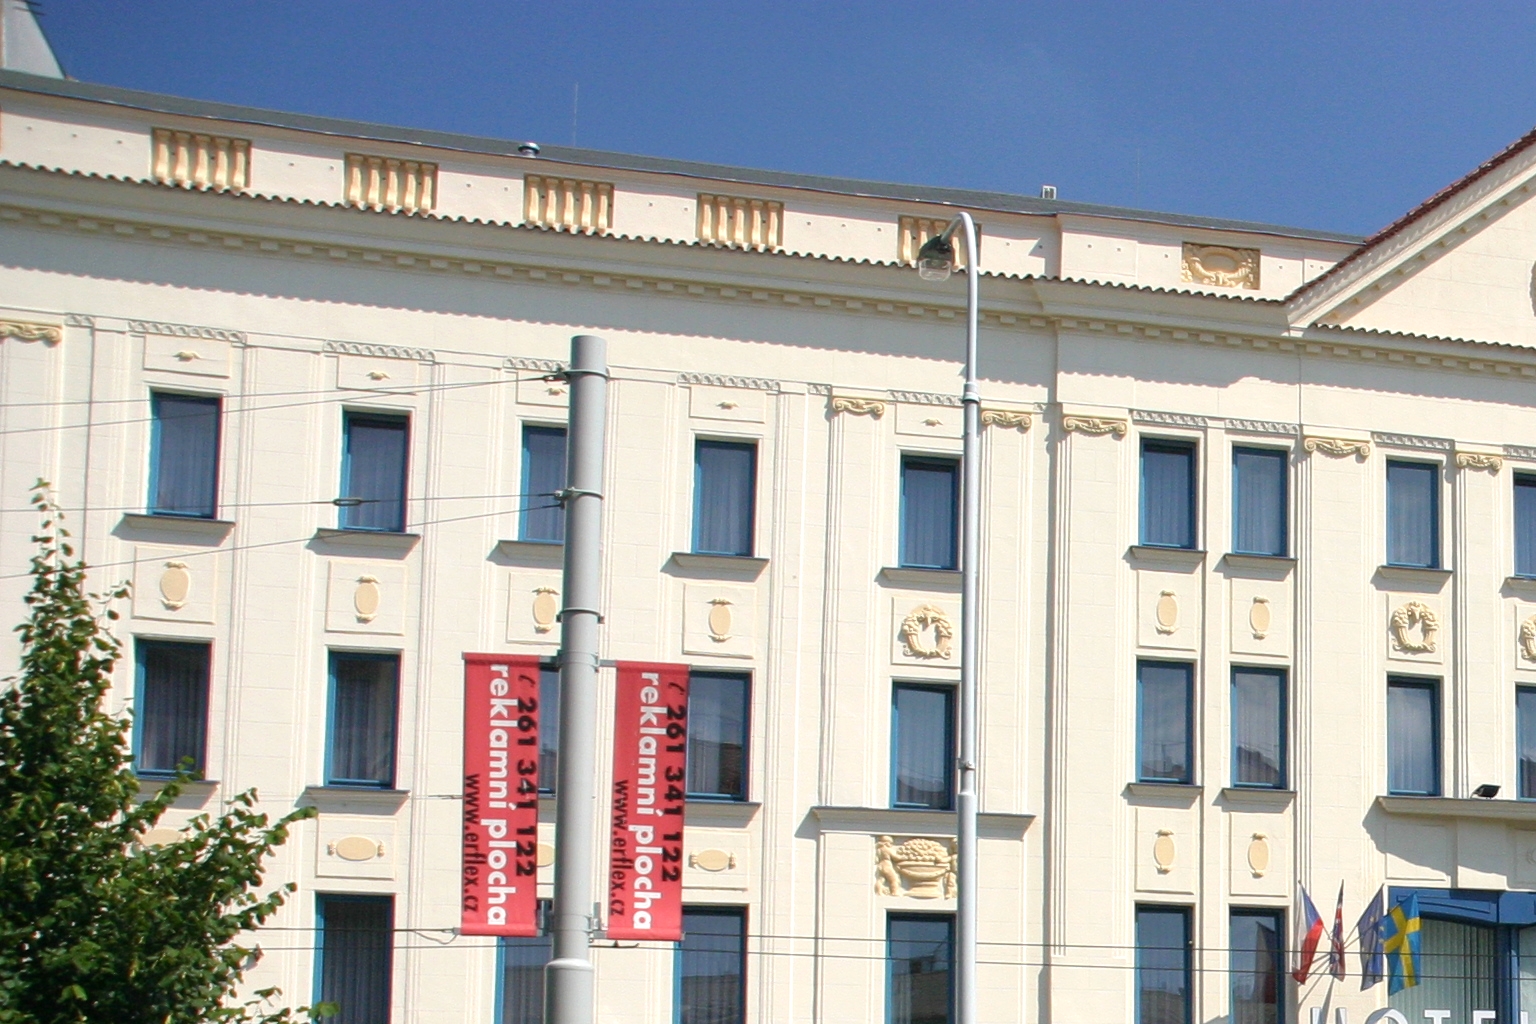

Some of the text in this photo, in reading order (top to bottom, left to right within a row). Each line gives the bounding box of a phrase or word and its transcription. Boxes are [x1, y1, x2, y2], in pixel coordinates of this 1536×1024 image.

[463, 773, 488, 912] www.erflex.cz
[480, 663, 519, 926] reklamní plocha
[515, 696, 538, 877] 261 341 122
[609, 780, 635, 916] www.erflex.cz
[627, 672, 669, 930] reklamní plocha
[661, 704, 687, 882] 261 341 122
